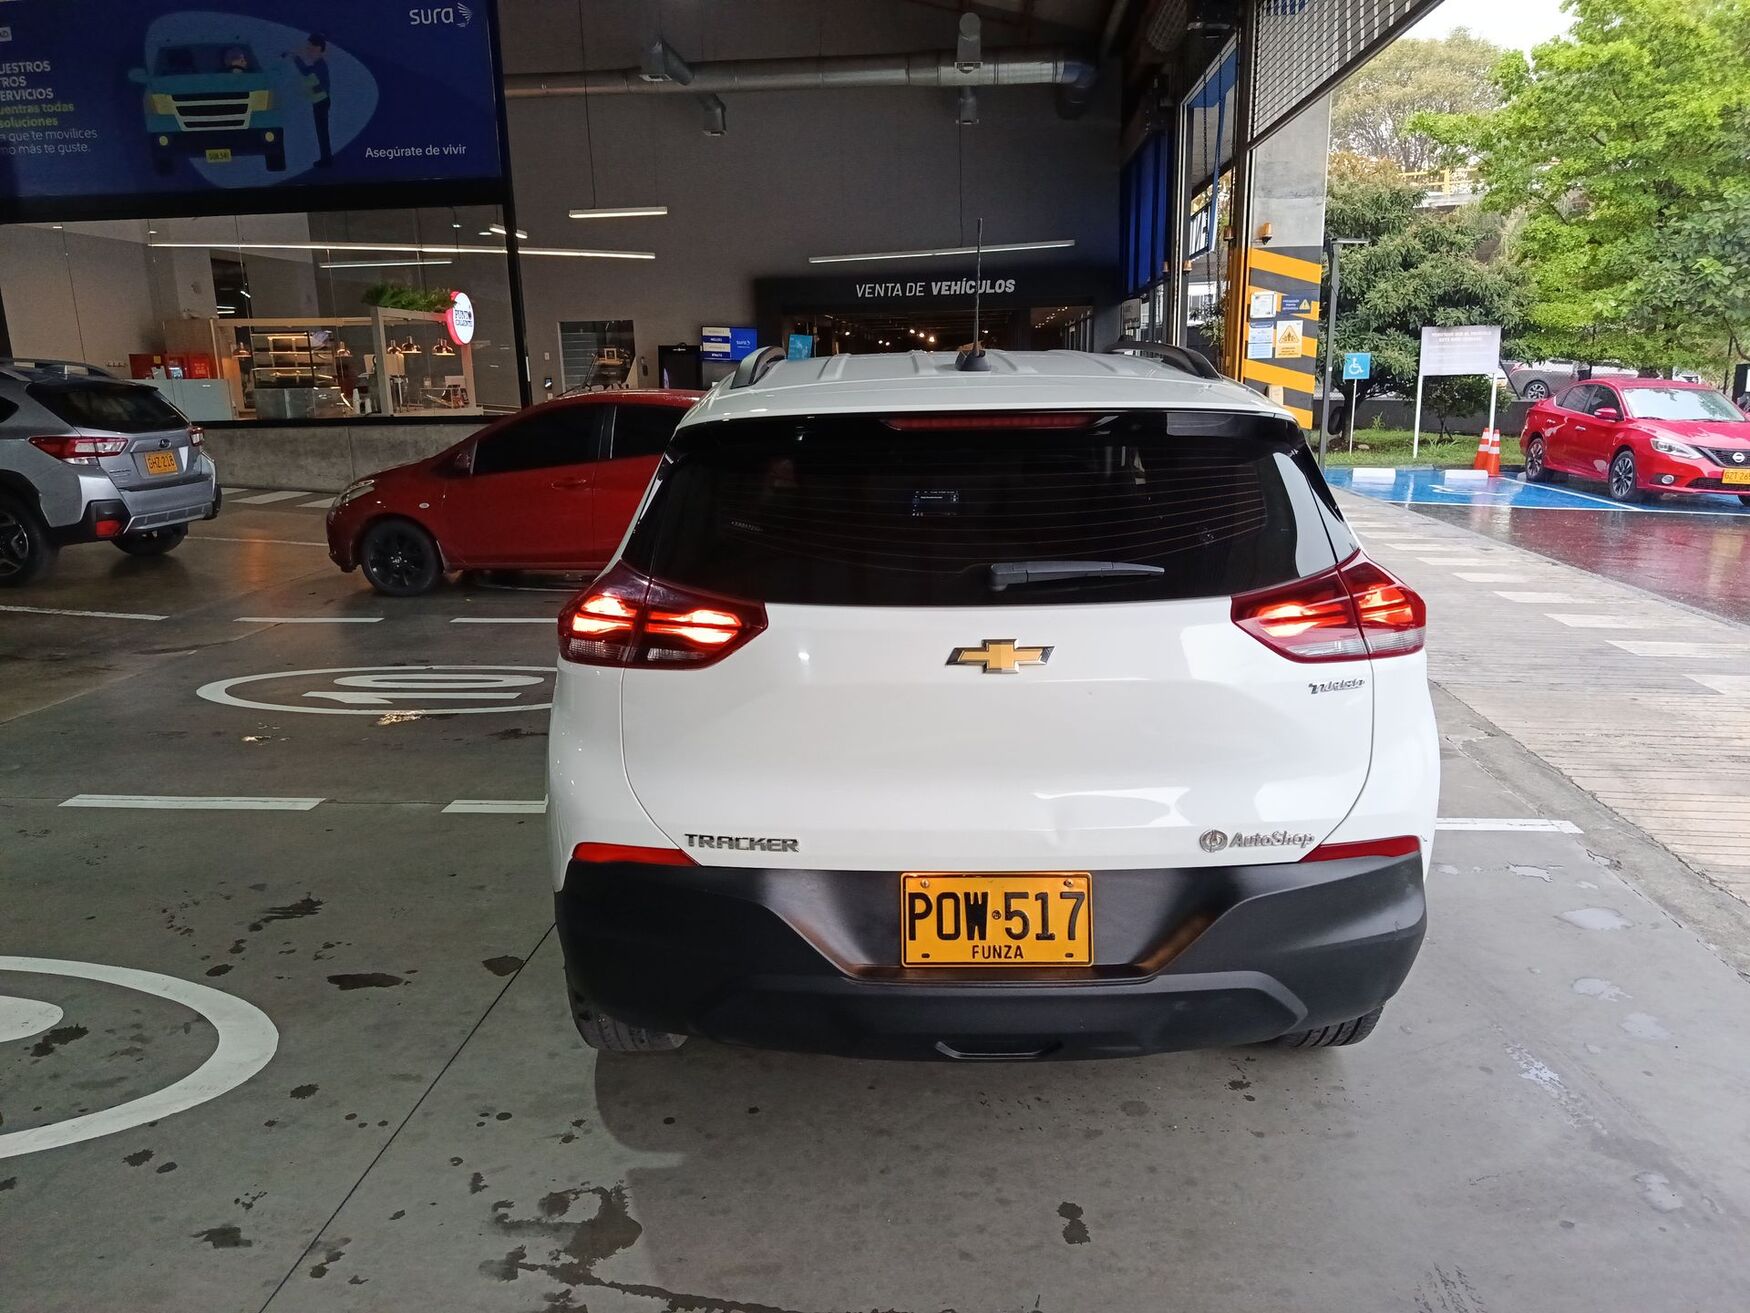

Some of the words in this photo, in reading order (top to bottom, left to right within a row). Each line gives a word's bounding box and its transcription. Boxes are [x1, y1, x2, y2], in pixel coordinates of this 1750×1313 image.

[409, 8, 454, 25] sura
[8, 132, 30, 142] que
[32, 131, 43, 140] te
[45, 128, 98, 139] movilices
[44, 144, 55, 153] te
[365, 147, 423, 159] Asegúrate
[425, 145, 440, 155] de
[442, 144, 467, 155] vivir
[856, 283, 902, 297] VENTA
[906, 282, 926, 296] DE
[931, 278, 1016, 295] VEHÍCULOS
[684, 833, 799, 852] TRACKER
[1229, 831, 1315, 848] AutoShop
[972, 944, 1024, 959] FUNZA
